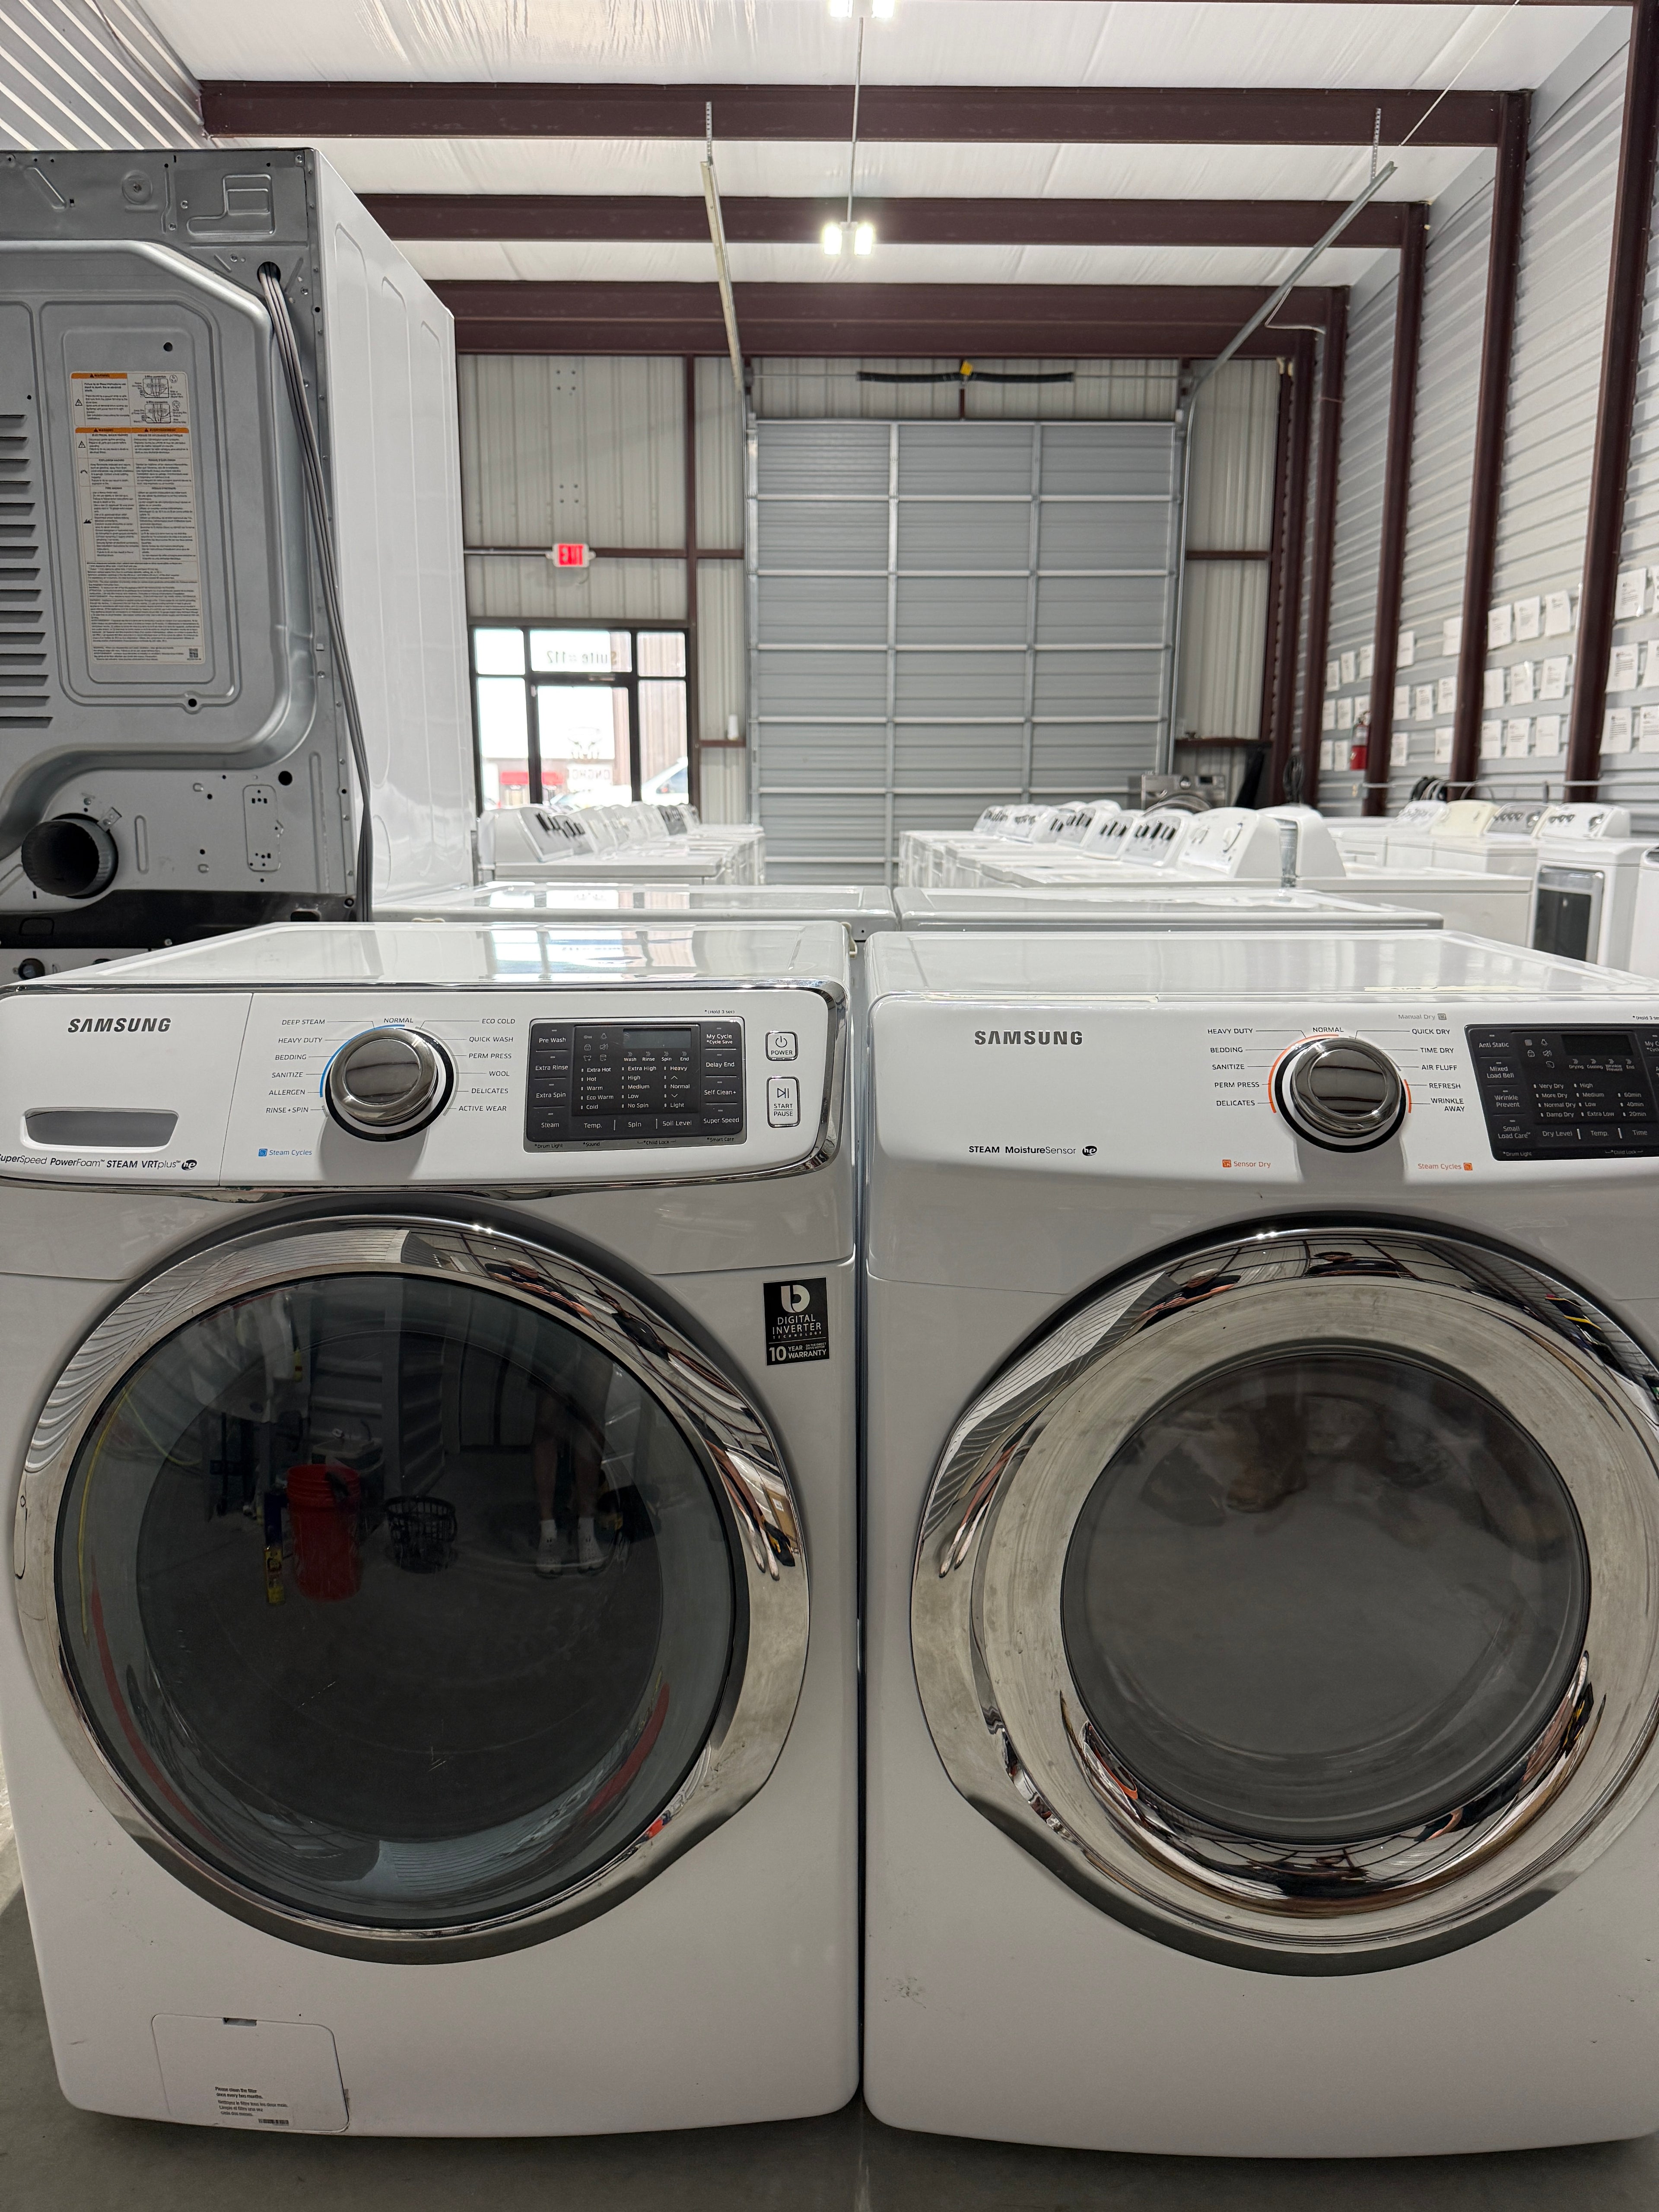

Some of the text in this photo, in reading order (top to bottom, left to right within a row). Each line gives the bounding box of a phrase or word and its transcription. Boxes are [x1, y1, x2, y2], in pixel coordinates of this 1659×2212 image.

[68, 1018, 171, 1033] SAMSUNG
[974, 1030, 1082, 1045] SAMSUNG
[1005, 1146, 1076, 1154] MoistureSensor
[778, 1314, 815, 1325] DIGITAL
[773, 1322, 821, 1335] INVERTER
[769, 1346, 786, 1361] 10
[788, 1349, 826, 1359] WARRANTY
